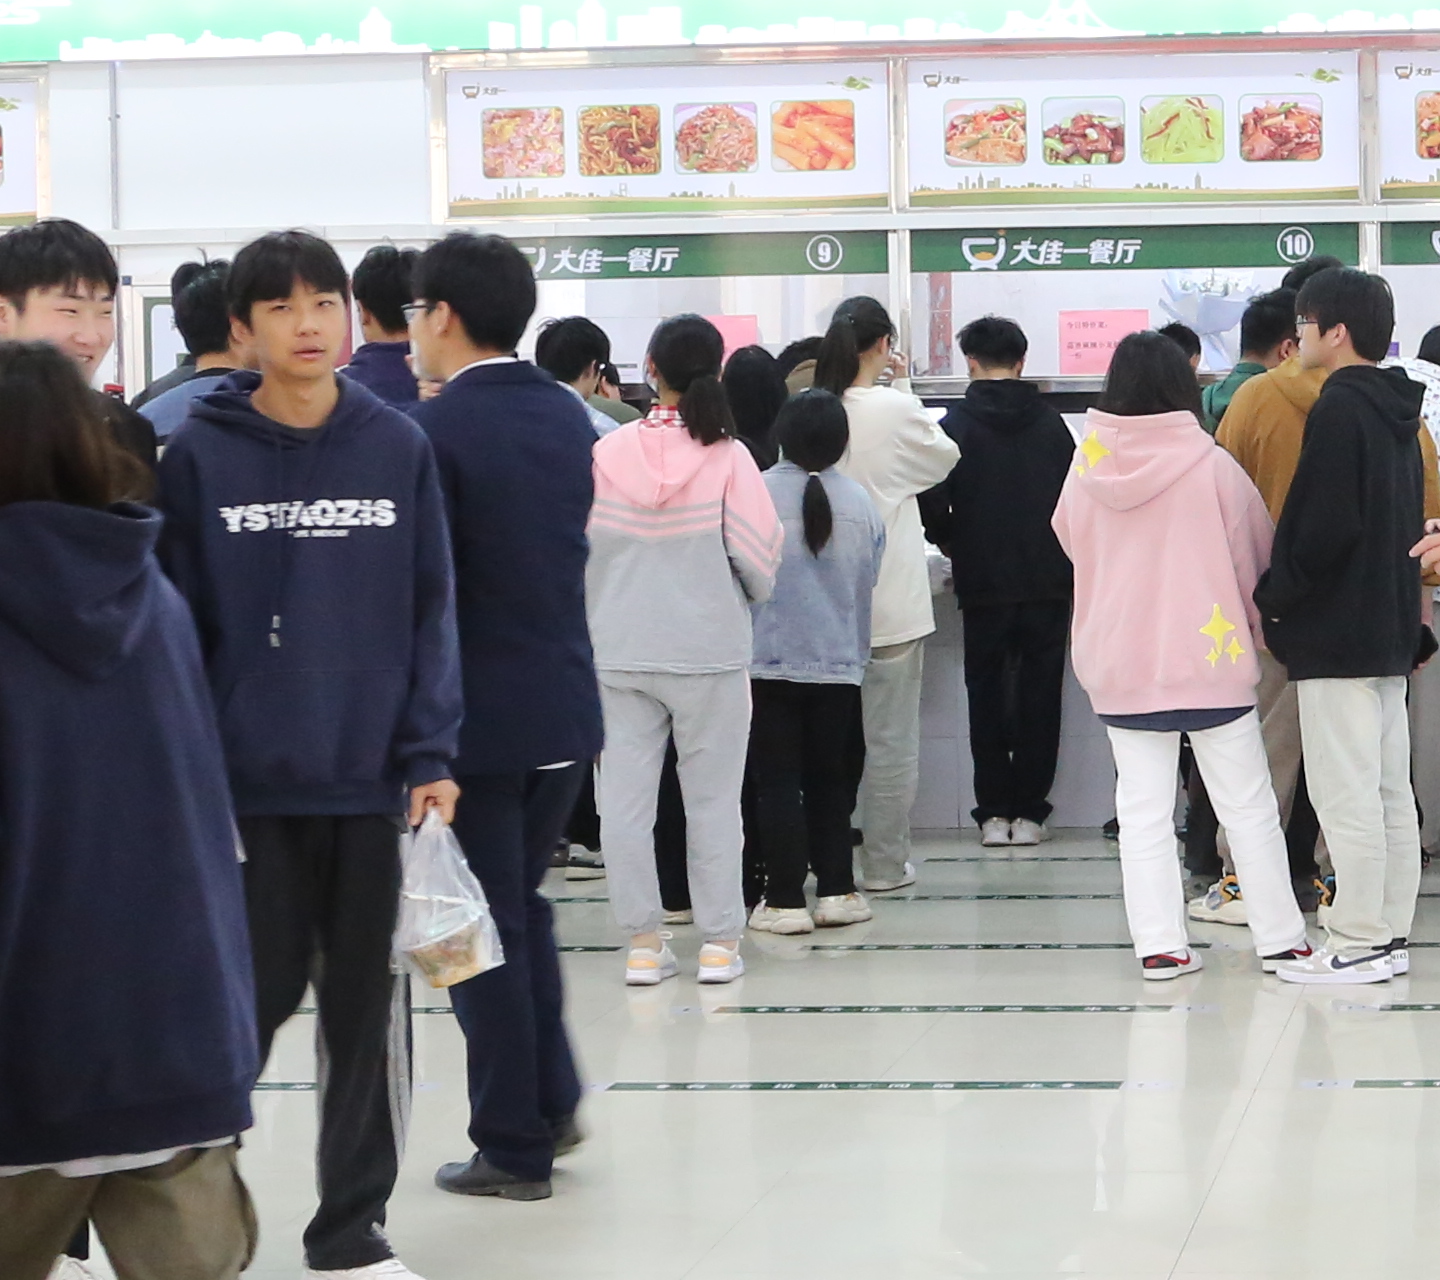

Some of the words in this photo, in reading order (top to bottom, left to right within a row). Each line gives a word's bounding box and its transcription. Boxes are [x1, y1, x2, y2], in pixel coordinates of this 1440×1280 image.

[550, 246, 680, 274] 大佳一餐厅
[1010, 237, 1142, 265] 大佳一餐厅
[1284, 235, 1306, 256] 10
